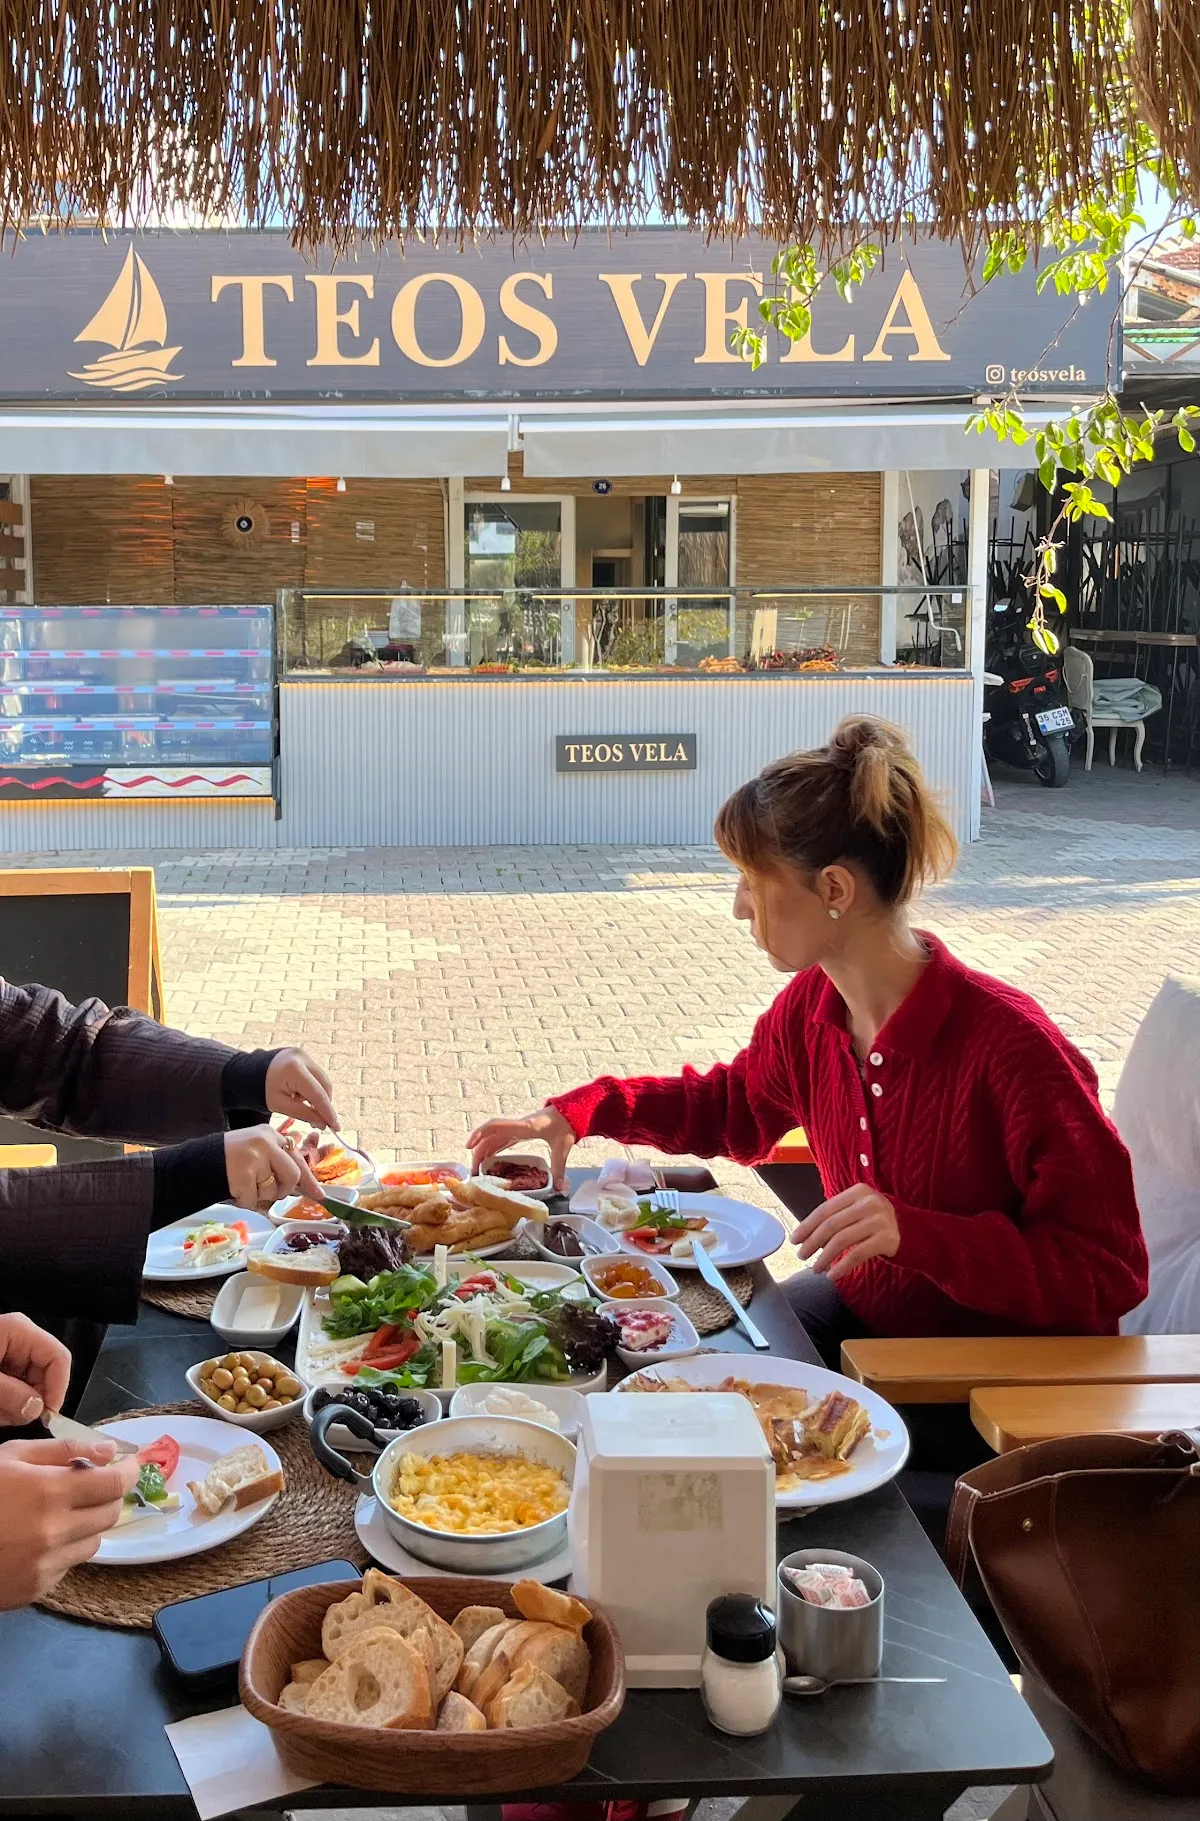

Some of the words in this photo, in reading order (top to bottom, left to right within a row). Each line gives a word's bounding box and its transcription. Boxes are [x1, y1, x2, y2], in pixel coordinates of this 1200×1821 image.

[211, 272, 558, 367] TEOS
[598, 270, 951, 366] VELA
[1010, 364, 1086, 382] teosvela
[1037, 713, 1050, 723] 35
[1051, 708, 1069, 719] CSM
[1055, 716, 1072, 727] 425
[564, 743, 624, 763] TEOS
[629, 742, 688, 762] VELA
